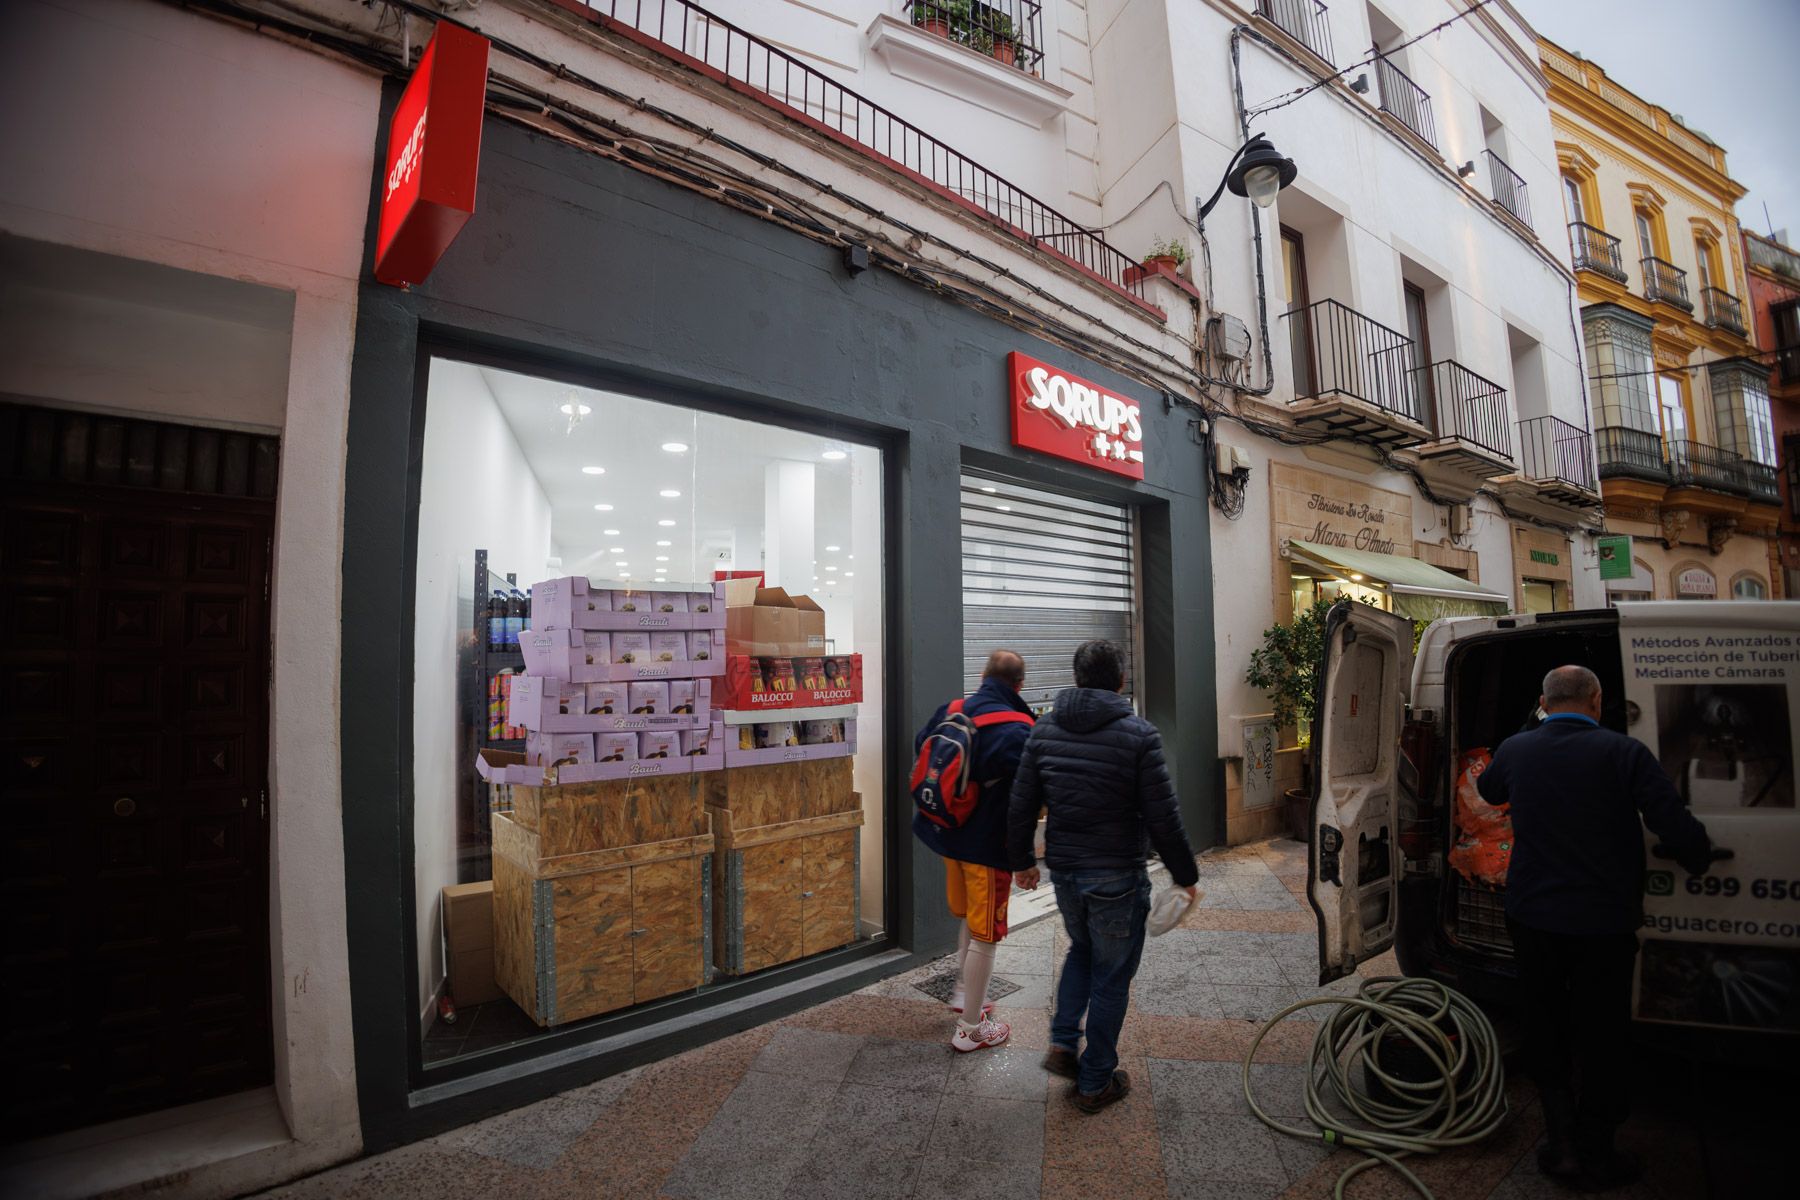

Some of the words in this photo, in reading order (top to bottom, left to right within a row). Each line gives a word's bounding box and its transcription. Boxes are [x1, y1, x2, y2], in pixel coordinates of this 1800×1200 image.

[1026, 367, 1143, 442] SQRUPS
[639, 616, 669, 626] Bauli
[1631, 637, 1700, 648] Métodos
[1705, 635, 1792, 648] Avanzados
[1633, 650, 1719, 665] Inspección
[1724, 651, 1744, 662] de
[638, 665, 669, 677] Bauli
[1635, 667, 1710, 679] Mediante
[1715, 666, 1785, 678] Cámaras
[751, 693, 794, 703] BALOCCO
[814, 690, 851, 700] BALOCCO
[613, 717, 647, 730] Bauli
[630, 762, 662, 774] Bauli
[1685, 875, 1740, 897] 699
[1644, 913, 1800, 937] aguacero.co
